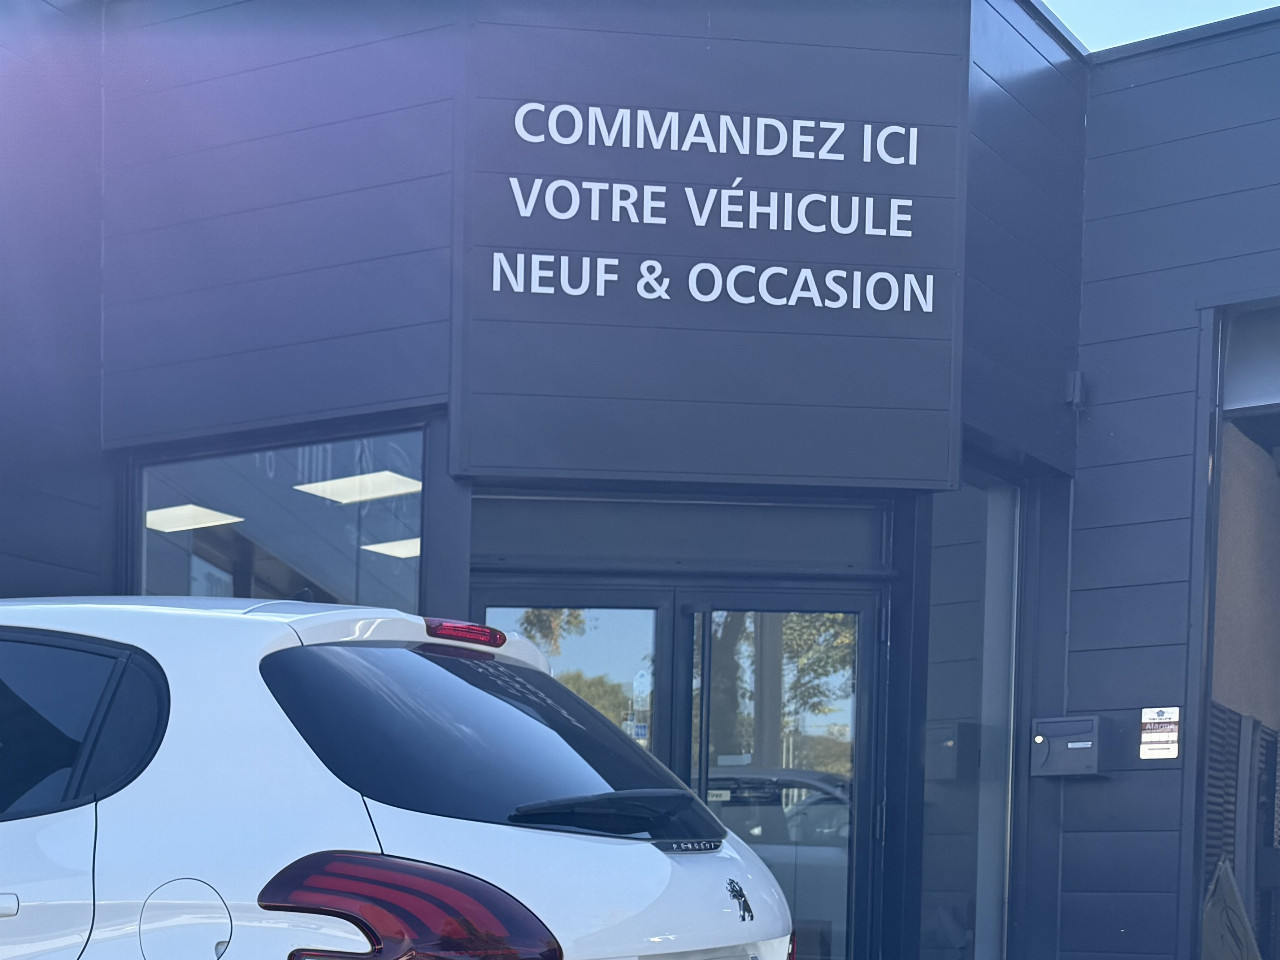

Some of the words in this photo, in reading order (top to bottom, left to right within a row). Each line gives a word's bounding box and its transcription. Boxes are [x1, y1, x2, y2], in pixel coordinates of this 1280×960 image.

[514, 102, 845, 161] COMMANDEZ
[863, 124, 918, 166] ICI
[509, 177, 667, 225] VOTRE
[684, 177, 913, 238] VÉHICULE
[492, 252, 619, 297] NEUF
[636, 260, 671, 300] &
[688, 262, 934, 313] OCCASION
